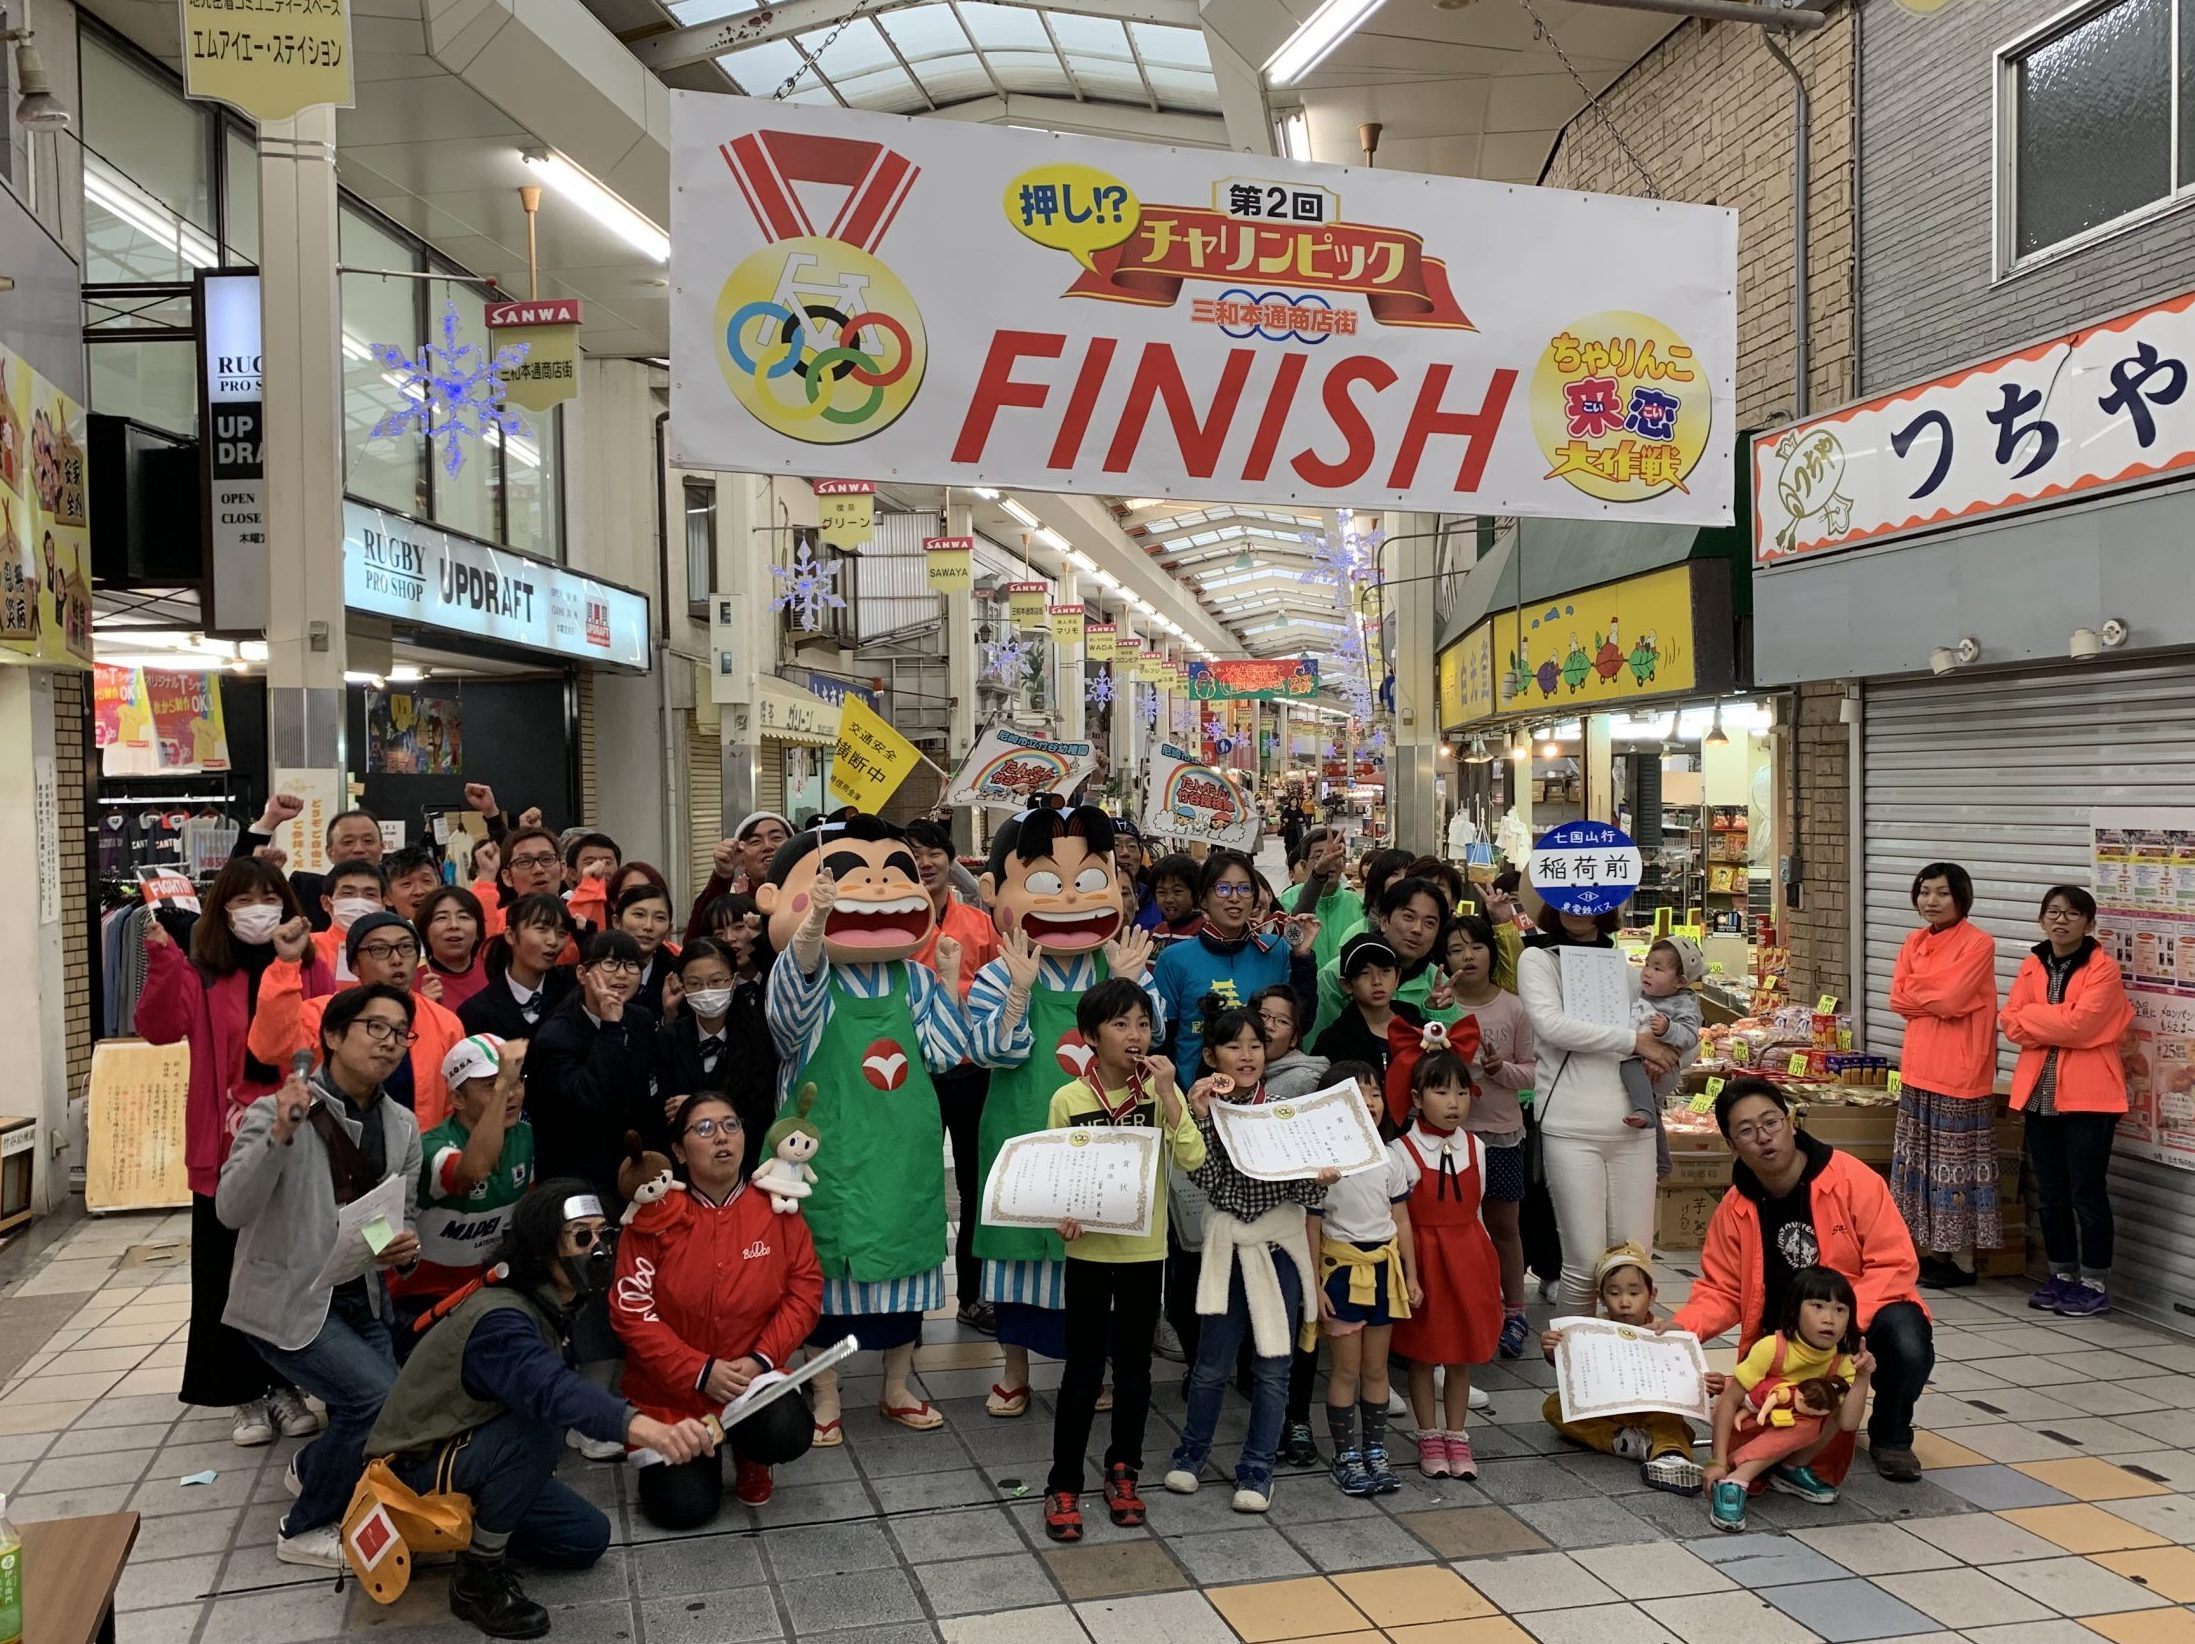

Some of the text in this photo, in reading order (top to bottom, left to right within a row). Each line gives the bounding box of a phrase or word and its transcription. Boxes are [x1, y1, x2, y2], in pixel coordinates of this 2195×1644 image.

[1229, 183, 1323, 223] 第2回
[1140, 219, 1405, 284] チャリンピック
[491, 303, 571, 324] SANWA
[1190, 298, 1358, 337] 三和本通商店街
[1552, 332, 1694, 382] ちゃりんこ
[220, 380, 251, 392] PRO
[951, 329, 1519, 494] FINISH
[1891, 341, 2187, 499] つちや
[218, 416, 253, 438] UP
[1544, 440, 1690, 495] 大作戦
[221, 493, 255, 504] OPEN
[817, 481, 870, 494] SANWA
[221, 513, 261, 524] CLOSE
[823, 517, 870, 529] グリーン
[239, 533, 265, 544] 木曜
[926, 539, 969, 549] SANWA
[363, 529, 426, 576] RUGBY
[930, 567, 968, 578] SAWAYA
[366, 570, 424, 602] PRO SHOP
[439, 557, 534, 623] UPDRAFT
[1009, 584, 1044, 592] SANWA
[1051, 606, 1082, 614] SANWA
[1056, 627, 1079, 635] マリモ
[849, 721, 897, 763] 交通安全
[836, 737, 886, 783] 横断中
[1554, 830, 1616, 843] 七国山行
[1539, 854, 1630, 880] 稲荷前
[438, 1216, 502, 1240] MAPEI
